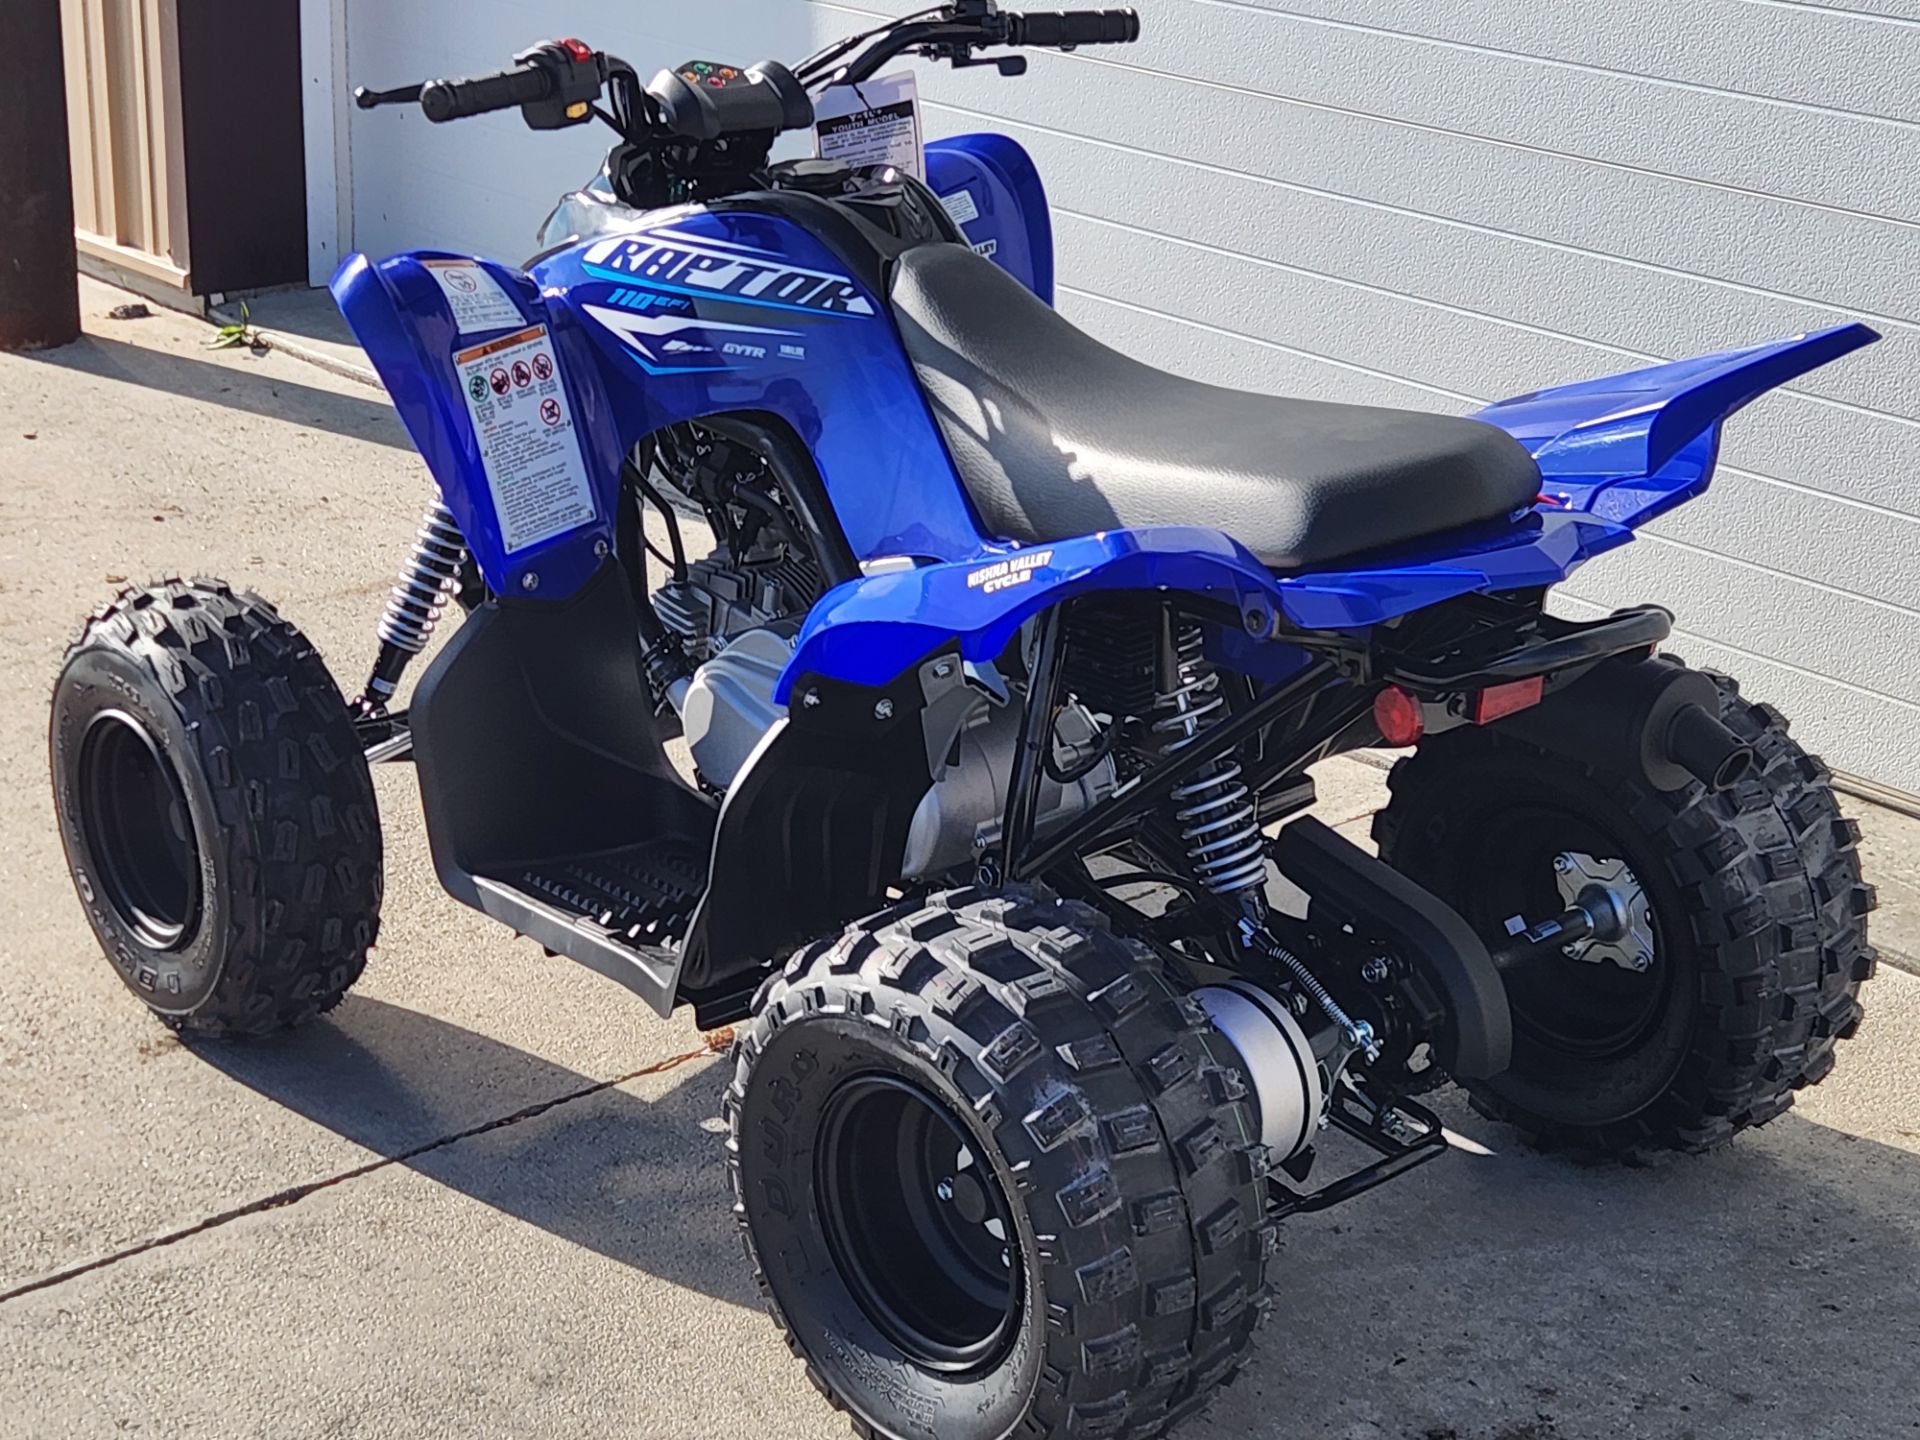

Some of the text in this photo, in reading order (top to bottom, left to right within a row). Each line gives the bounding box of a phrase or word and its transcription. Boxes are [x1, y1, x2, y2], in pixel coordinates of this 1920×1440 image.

[832, 120, 863, 133] YOUTH
[601, 239, 854, 312] RAPTOR
[722, 342, 766, 359] GYTR
[1010, 550, 1053, 572] VALLEY
[983, 569, 1032, 594] CYCLE
